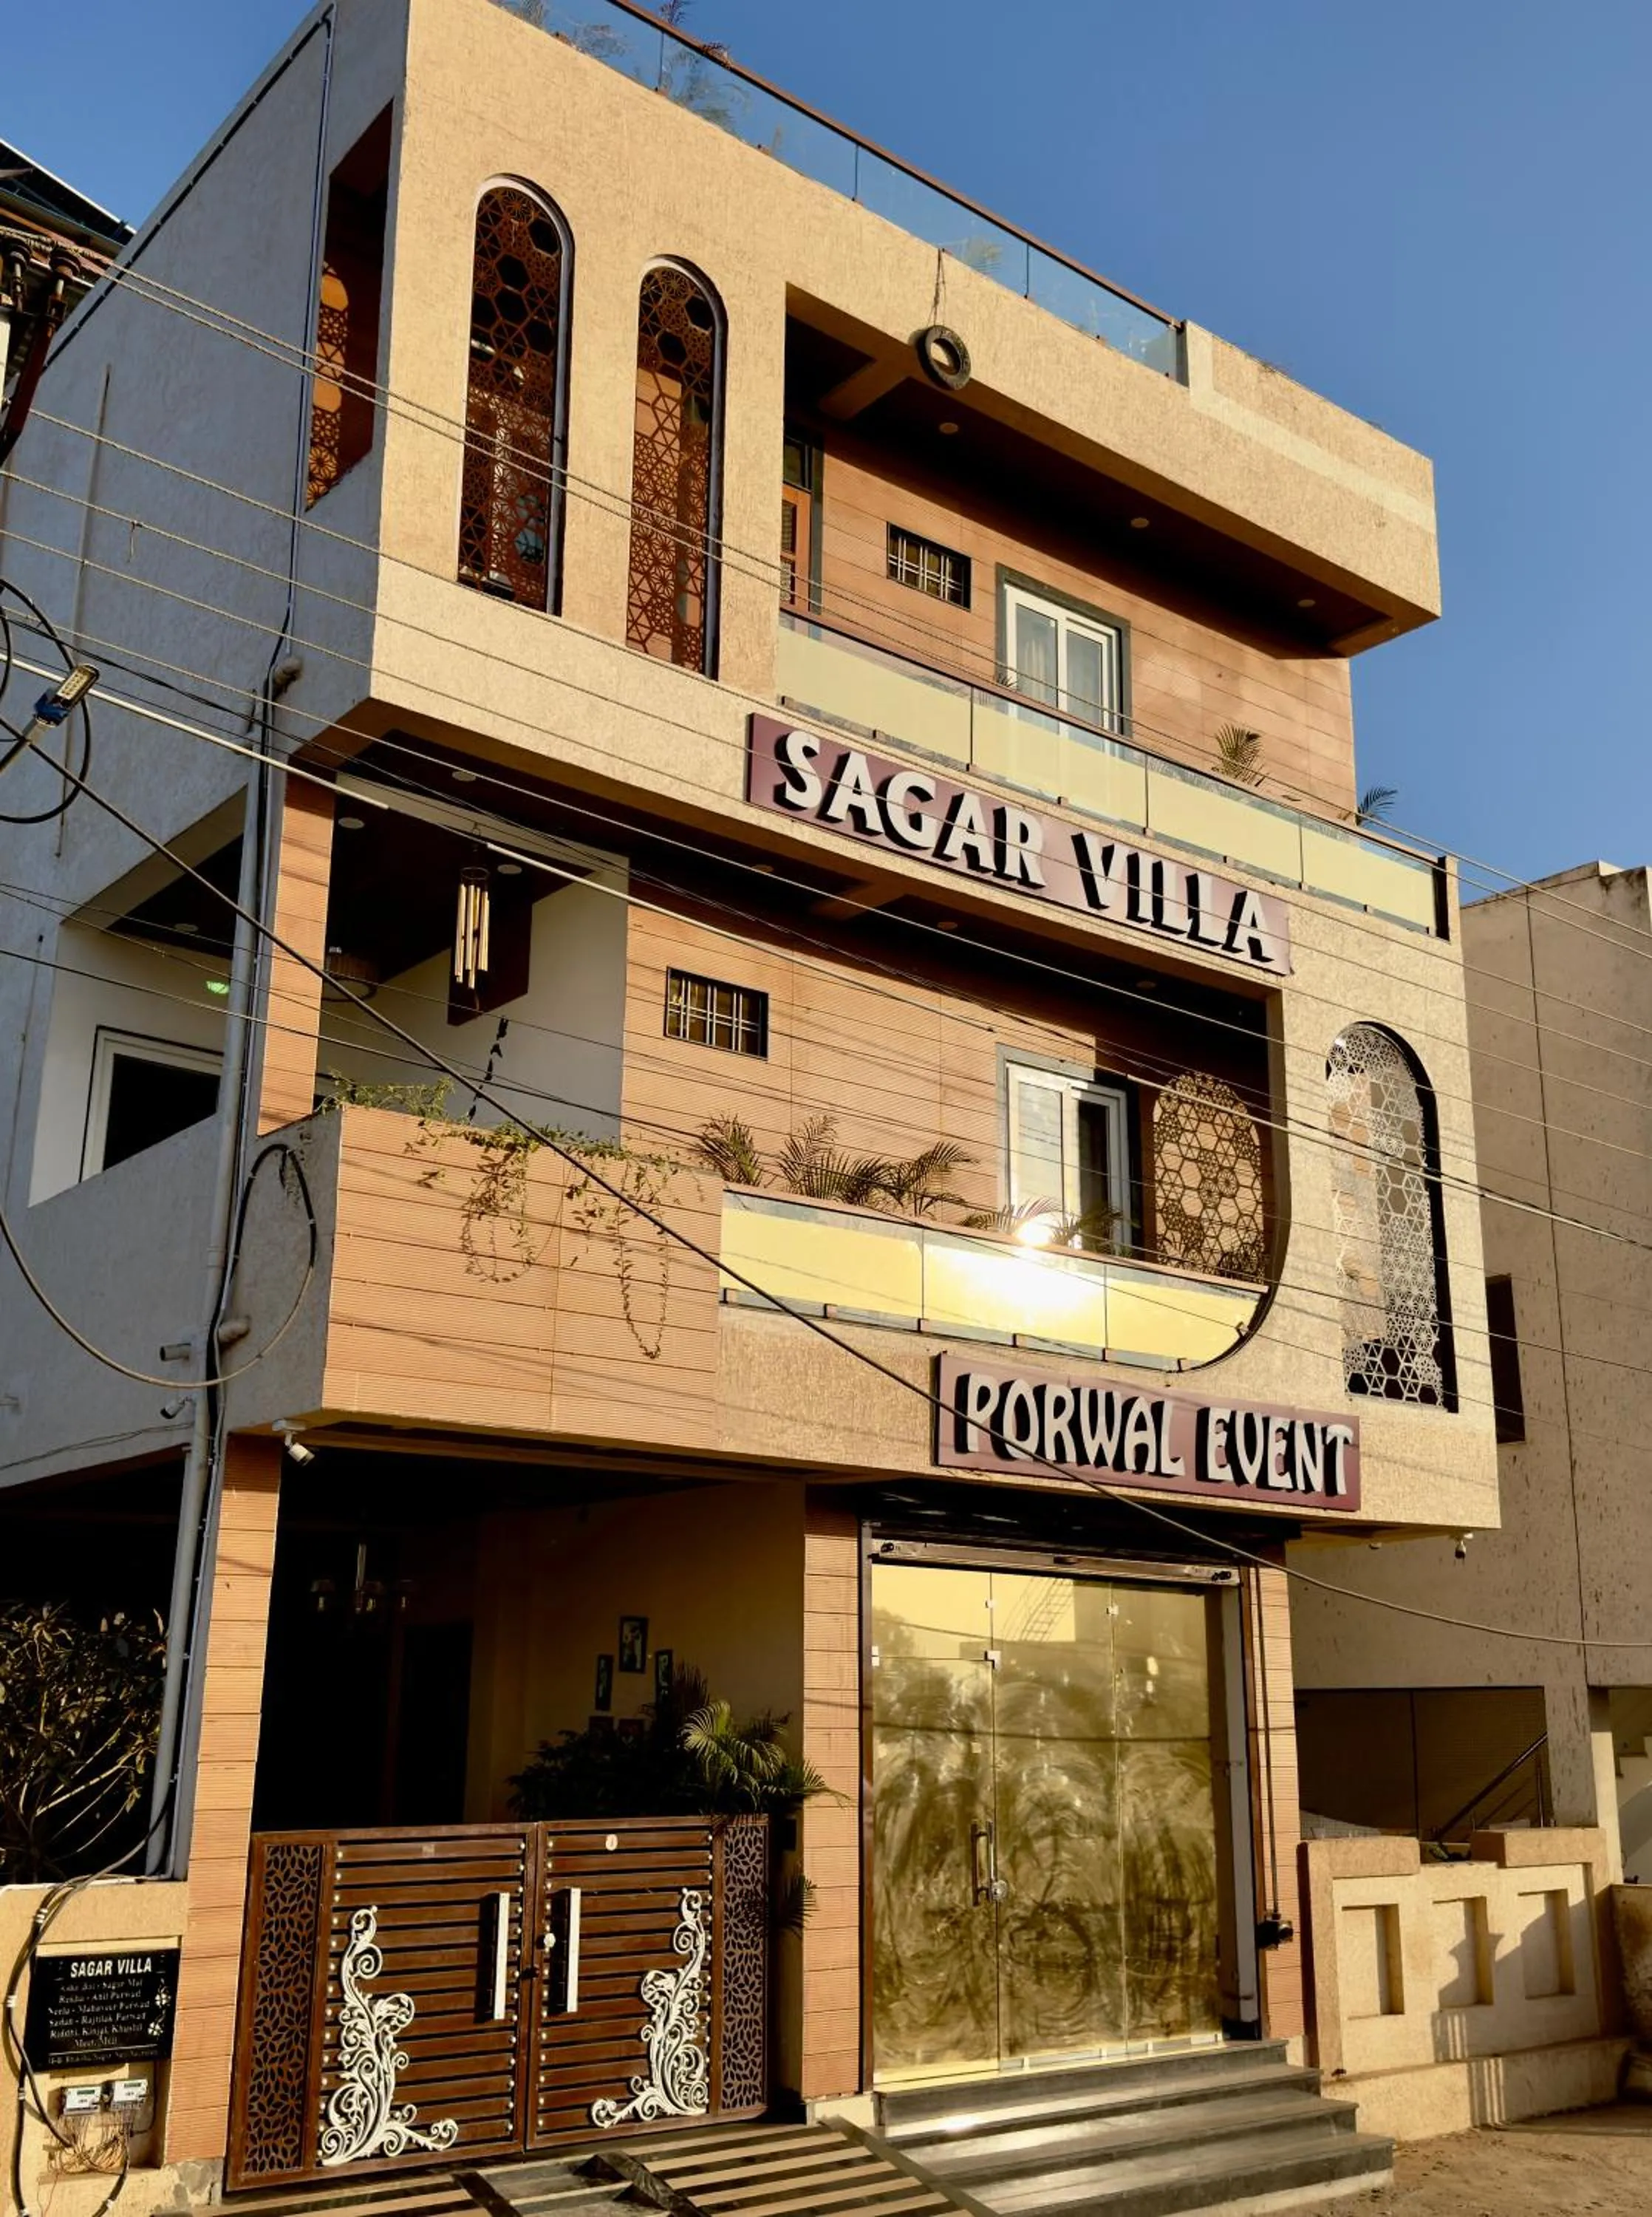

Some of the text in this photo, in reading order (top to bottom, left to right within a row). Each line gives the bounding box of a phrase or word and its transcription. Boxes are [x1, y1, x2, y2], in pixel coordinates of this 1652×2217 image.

[775, 730, 1274, 961] SAGAR VILLA
[955, 1373, 1354, 1496] PORWAL EVENT
[70, 1957, 152, 1978] SAGAR VILLA
